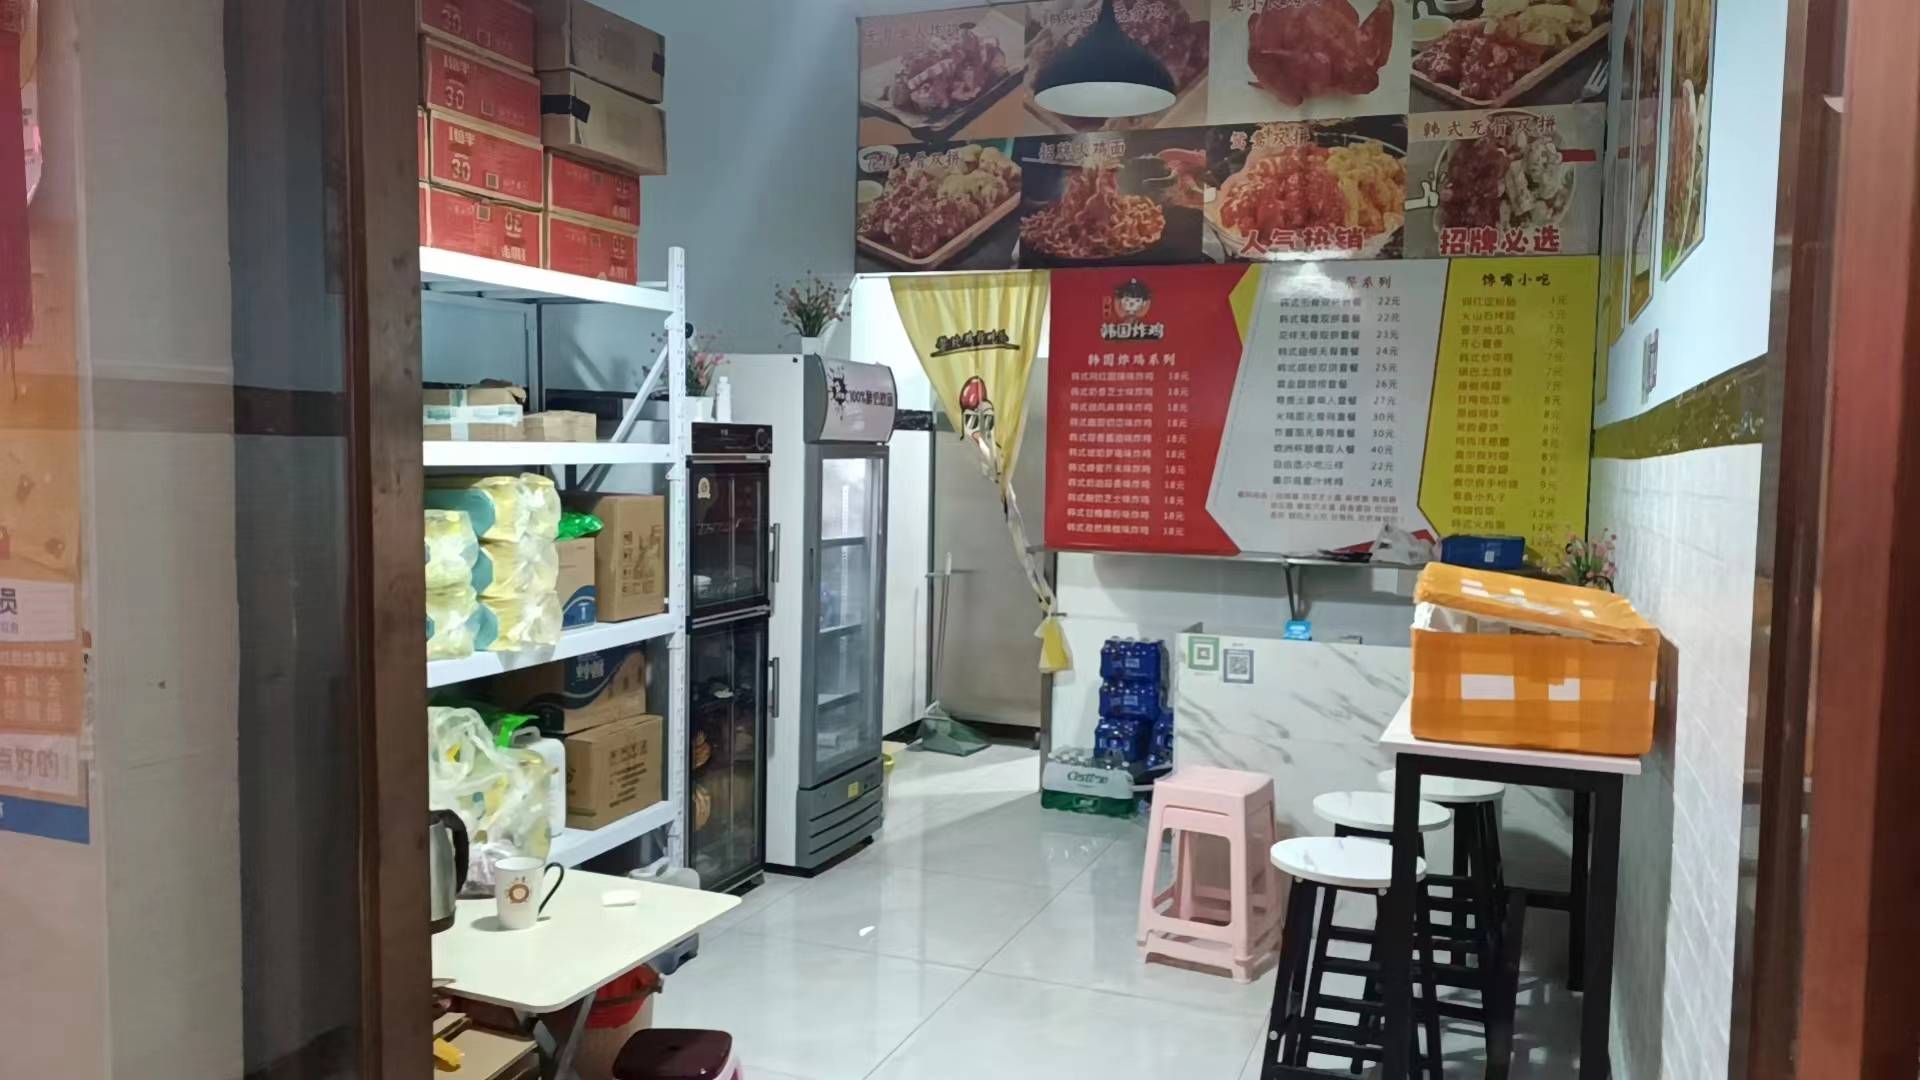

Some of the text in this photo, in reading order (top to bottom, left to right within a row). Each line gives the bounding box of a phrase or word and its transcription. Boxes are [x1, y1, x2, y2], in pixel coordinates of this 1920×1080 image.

[445, 85, 465, 110] 30
[452, 158, 471, 182] 30
[1243, 227, 1366, 254] 人气热销
[1439, 227, 1561, 256] 招牌必选
[1482, 273, 1551, 287] 馋嘴小吃
[1377, 297, 1400, 307] 22元
[1377, 313, 1400, 323] 22元
[1101, 322, 1164, 339] 韩国炸鸡
[1375, 346, 1398, 356] 24元
[1088, 353, 1176, 367] 韩国炸鸡系列
[1375, 363, 1398, 372] 25元
[1168, 372, 1189, 382] 18元
[1375, 379, 1398, 389] 26元
[1168, 387, 1189, 396] 18元
[1374, 396, 1396, 406] 27元
[1168, 403, 1188, 412] 18元
[1372, 412, 1395, 422] 30元
[1167, 418, 1187, 428] 18元
[1166, 434, 1187, 444] 18元
[1372, 429, 1394, 439] 30元
[1166, 450, 1186, 459] 18元
[1371, 445, 1393, 455] 40元
[1165, 465, 1185, 475] 18元
[1371, 462, 1393, 472] 22元
[1165, 481, 1184, 490] 18元
[1370, 478, 1393, 488] 24元
[1164, 496, 1184, 506] 18元
[1164, 512, 1184, 521] 18元
[1163, 527, 1184, 536] 18元
